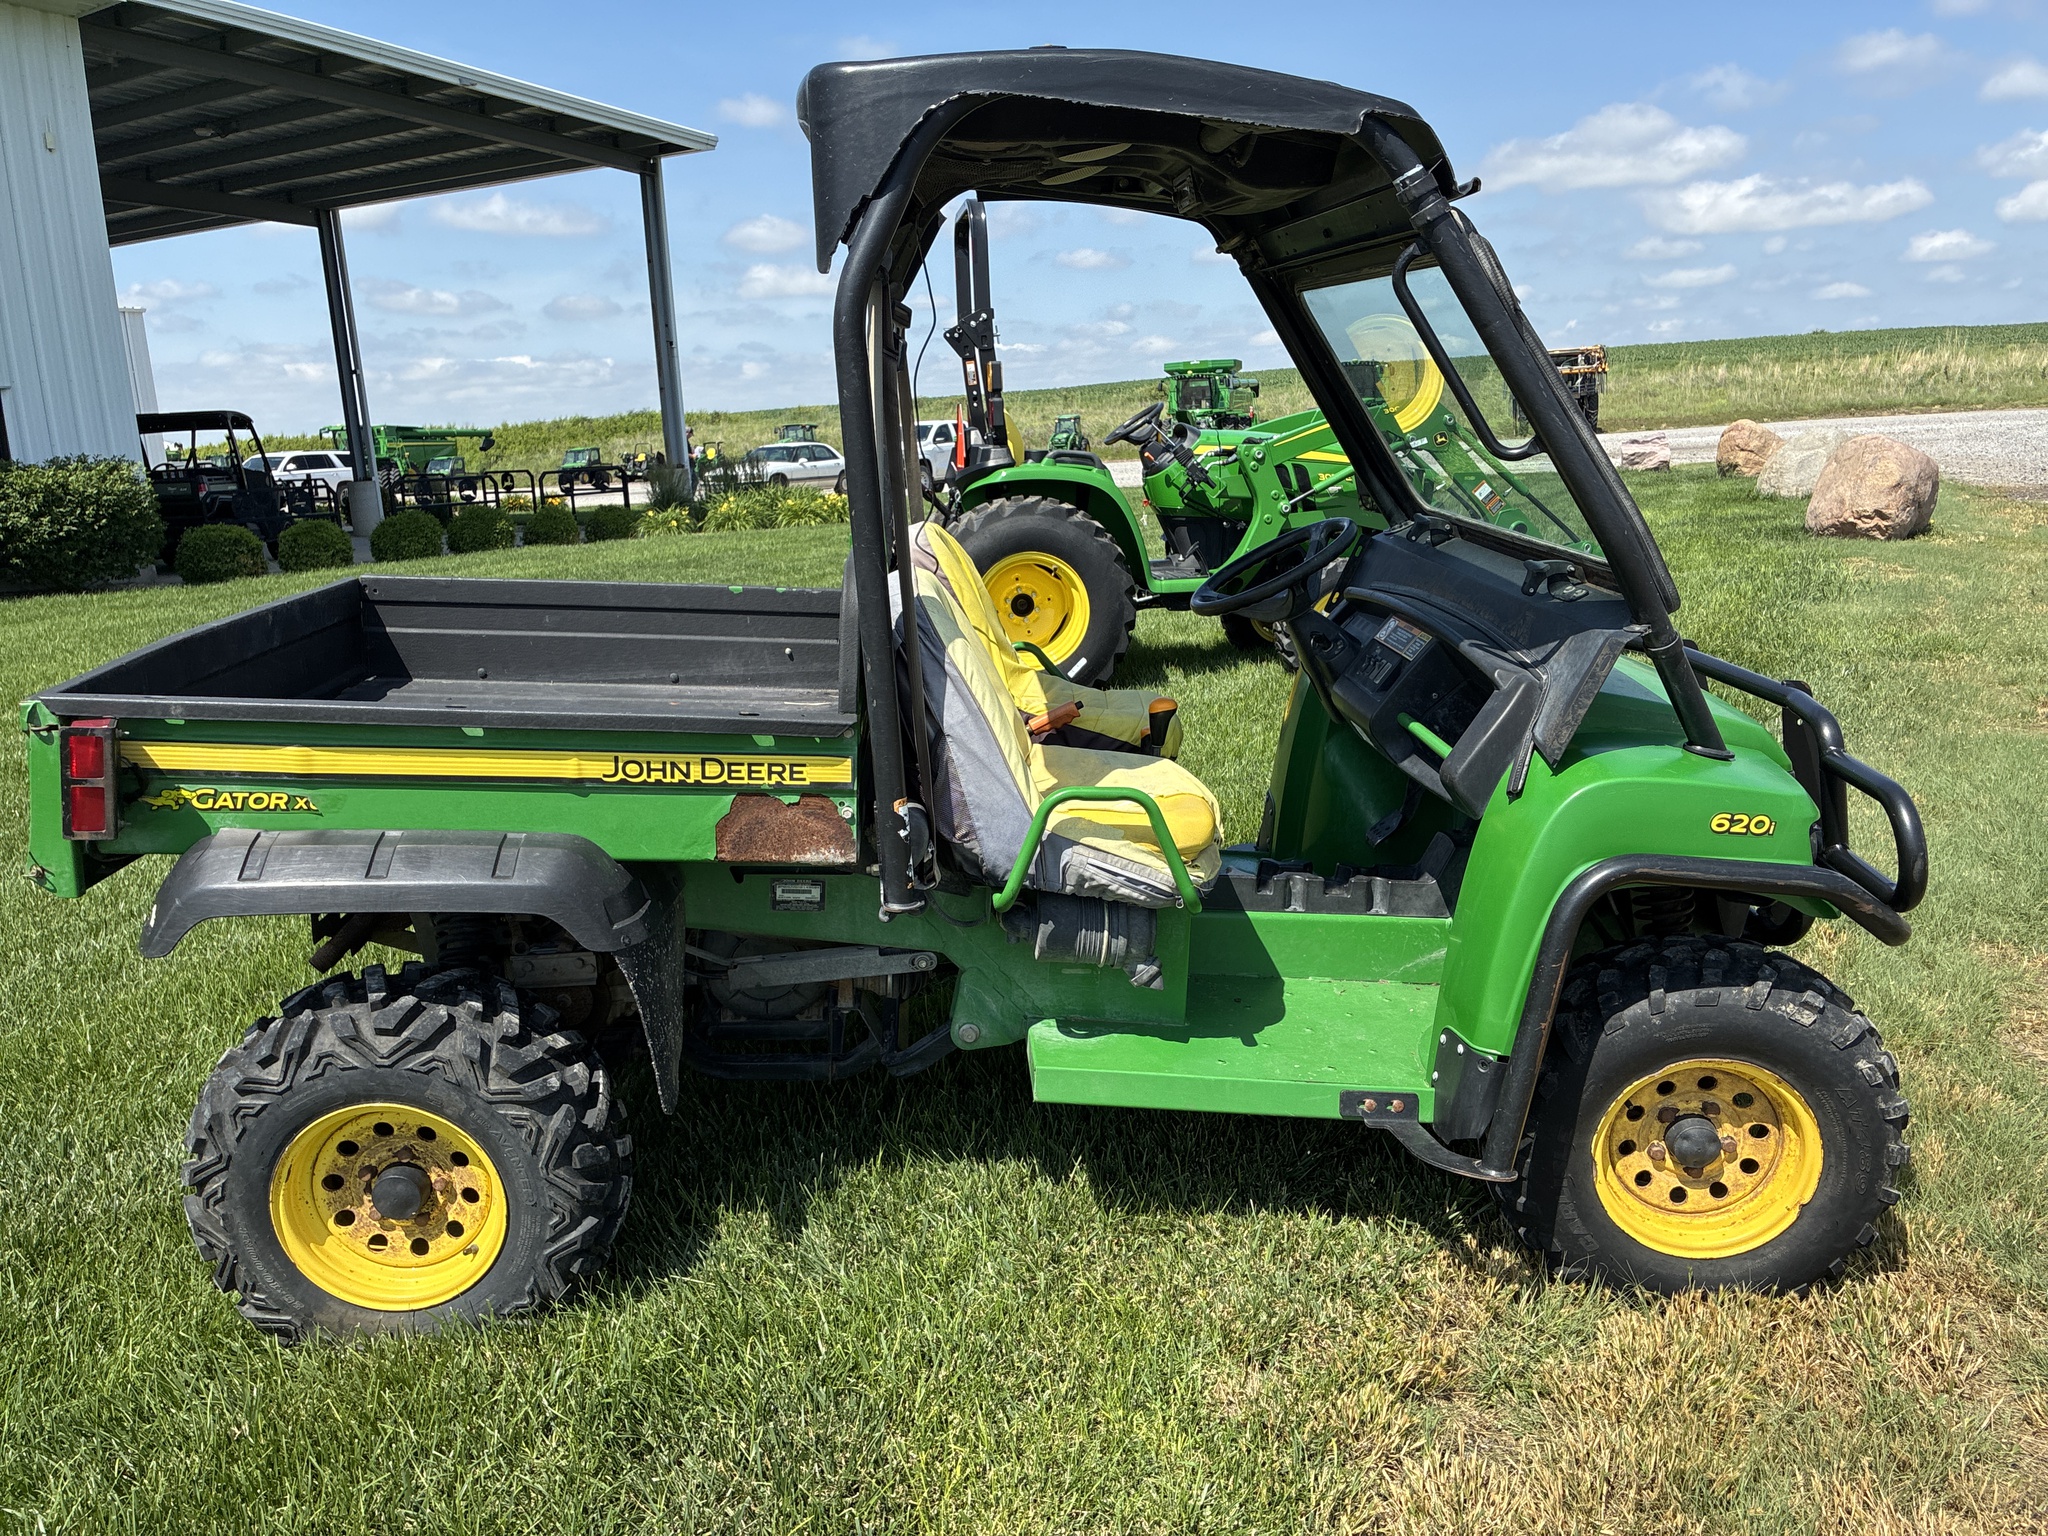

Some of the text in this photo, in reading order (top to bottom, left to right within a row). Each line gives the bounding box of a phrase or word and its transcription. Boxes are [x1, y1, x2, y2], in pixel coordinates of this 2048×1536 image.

[602, 754, 808, 783] JOHN DEERE
[190, 787, 291, 812] GATOR
[1710, 812, 1777, 836] 620i
